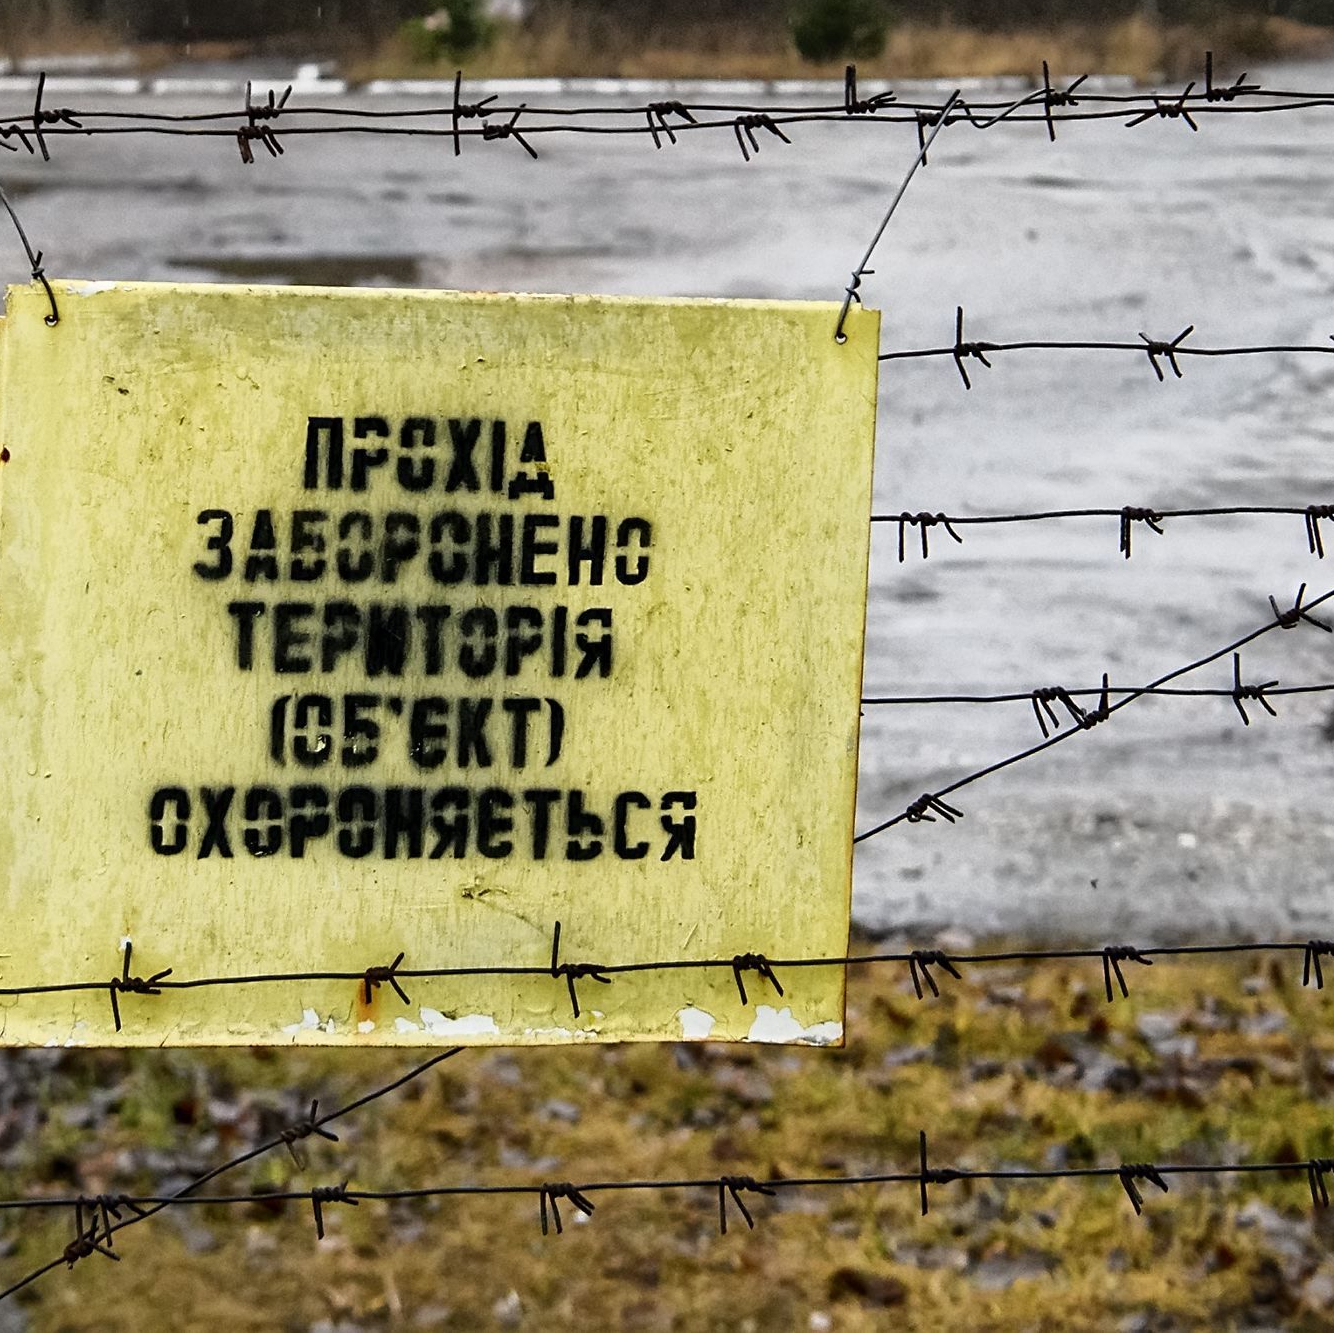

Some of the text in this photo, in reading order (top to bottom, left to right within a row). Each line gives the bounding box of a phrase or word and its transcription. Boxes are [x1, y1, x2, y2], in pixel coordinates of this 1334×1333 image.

[302, 415, 555, 500] ПРОХІД
[192, 509, 652, 587] ЗАБОРОНЕНО
[227, 600, 614, 680] ТЕРИТОРІЯ
[269, 693, 565, 771] (ОБ'ЄКТ)
[148, 785, 697, 862] ОХОРОНЯЄТЬСЯ
